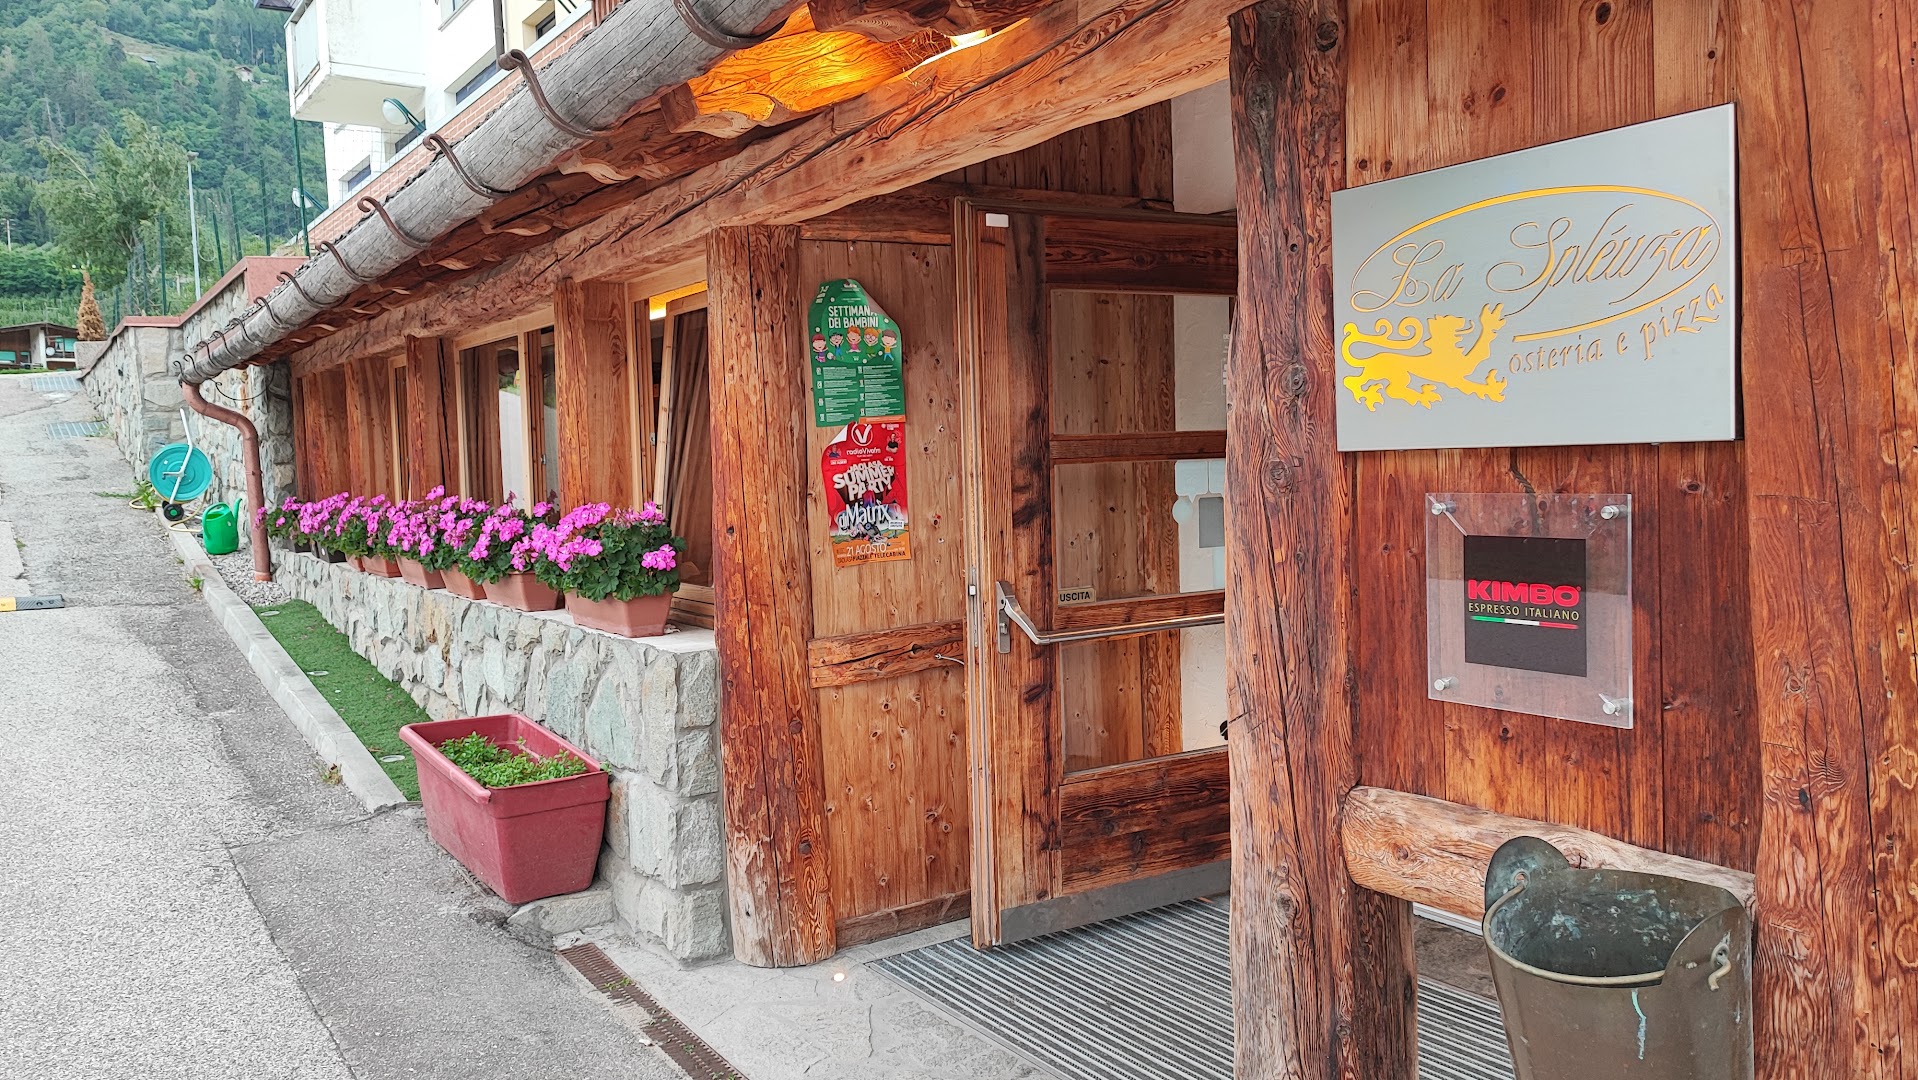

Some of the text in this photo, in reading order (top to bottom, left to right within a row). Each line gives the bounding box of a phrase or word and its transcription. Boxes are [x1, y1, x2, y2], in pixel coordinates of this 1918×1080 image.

[1350, 239, 1465, 313] La
[828, 316, 879, 329] DEI BAMBINI
[1508, 282, 1725, 375] osteria e pizza
[832, 465, 895, 489] SUMMER
[848, 476, 892, 501] PARTY
[855, 543, 887, 555] AGOSTO
[1059, 591, 1091, 602] USCITA
[1467, 579, 1580, 607] KIMBO
[1468, 602, 1580, 621] ESPRESSO ITALIANO
